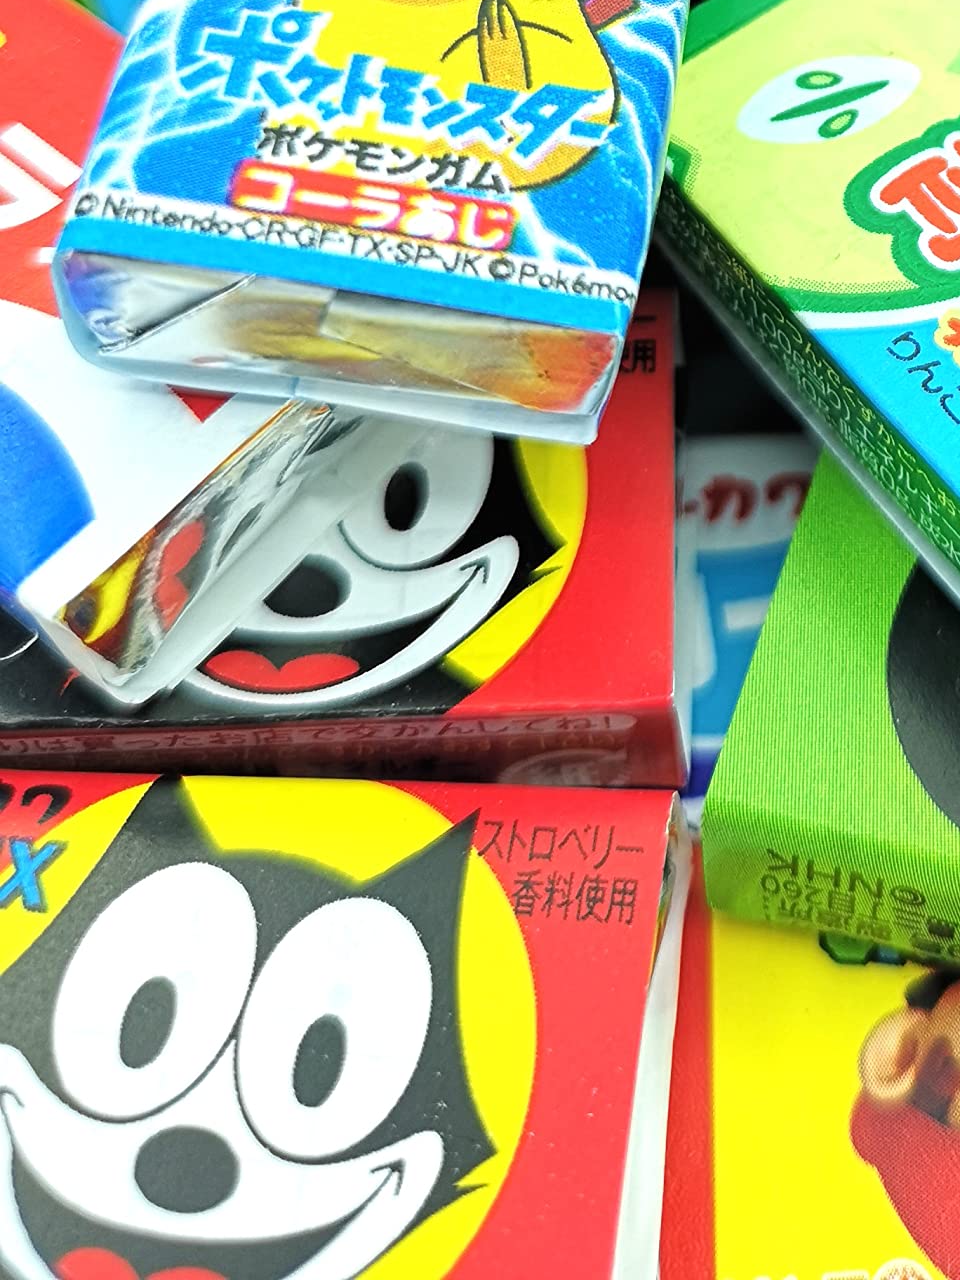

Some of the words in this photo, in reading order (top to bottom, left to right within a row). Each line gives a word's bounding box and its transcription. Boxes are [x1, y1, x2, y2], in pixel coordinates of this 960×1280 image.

[178, 9, 616, 161] ポケットモンスター
[258, 122, 506, 194] ポケモンガム
[243, 166, 512, 249] コーラあじ
[682, 472, 812, 526] カワ
[0, 839, 70, 913] X
[478, 820, 646, 865] ストロベリー
[514, 872, 639, 925] 香料使用
